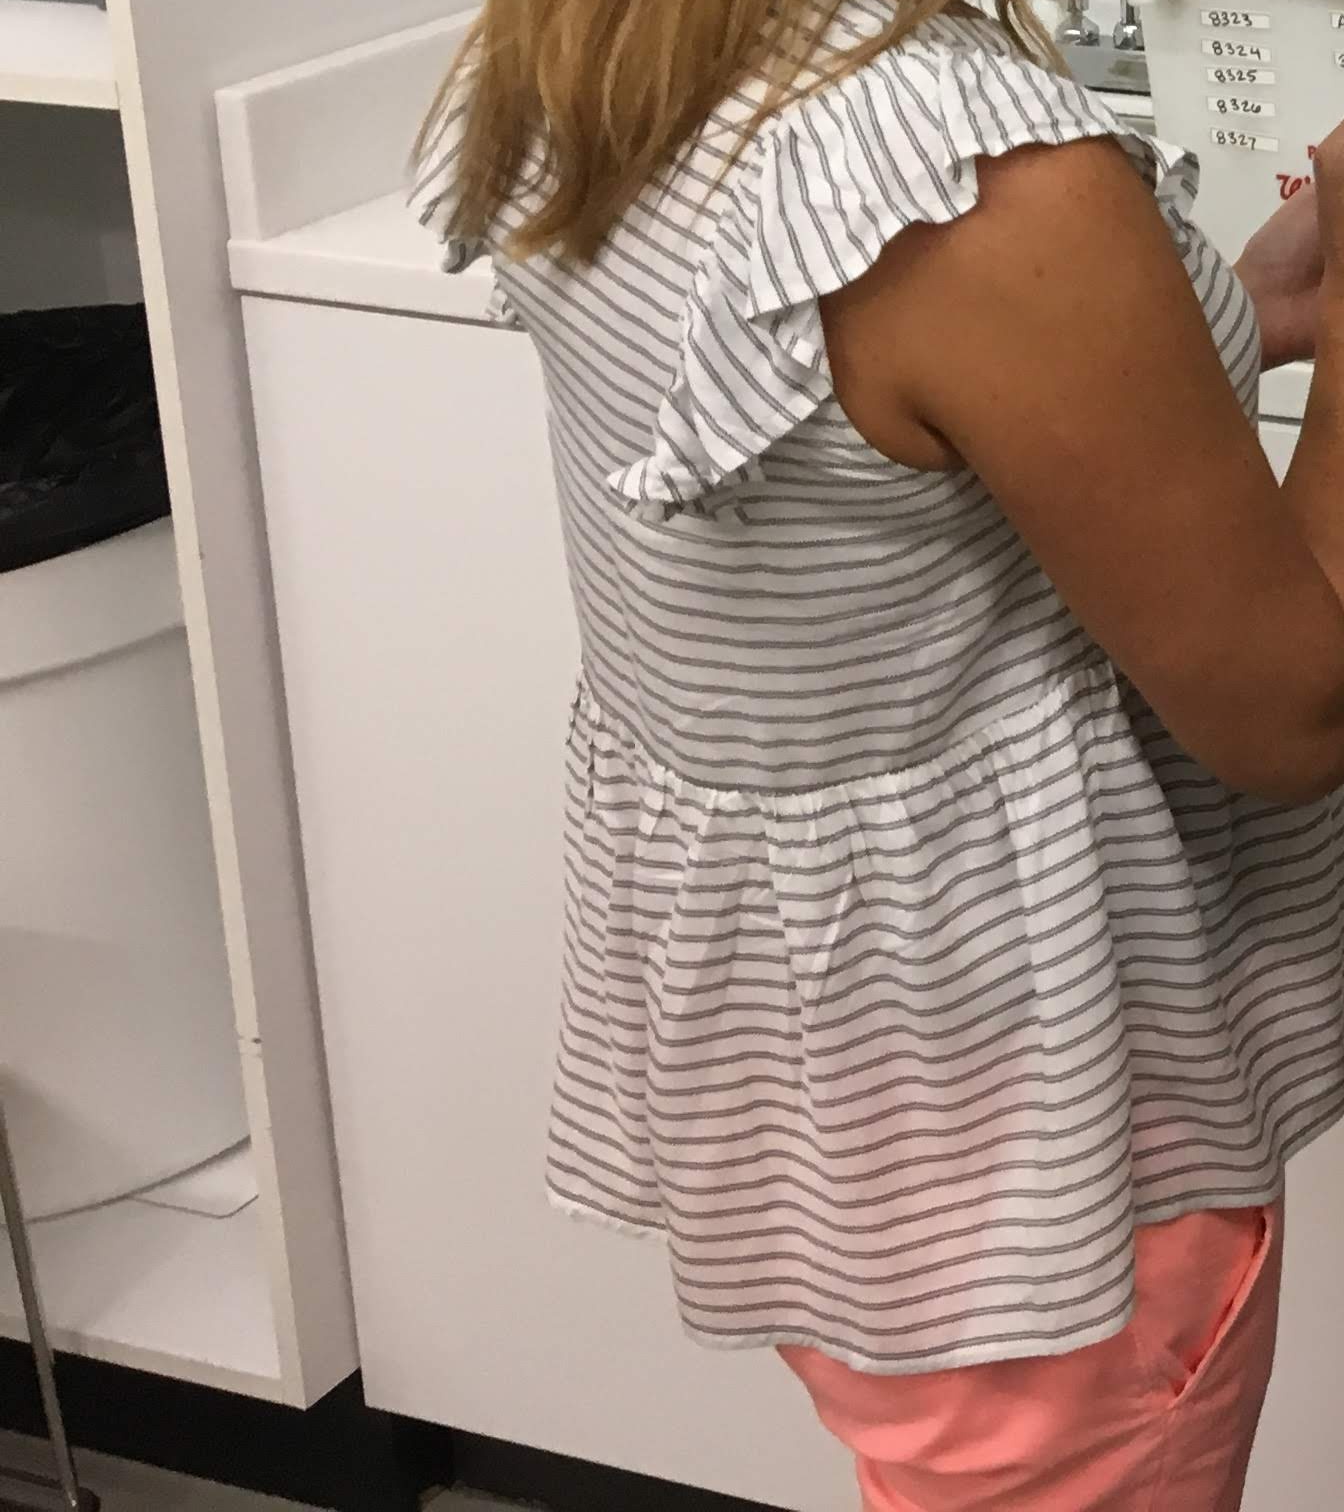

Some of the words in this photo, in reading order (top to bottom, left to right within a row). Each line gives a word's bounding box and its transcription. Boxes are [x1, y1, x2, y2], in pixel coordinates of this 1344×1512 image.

[1208, 10, 1253, 28] 8323
[1211, 40, 1262, 61] 8324
[1213, 69, 1258, 84] 8325
[1216, 97, 1262, 114] 8326
[1215, 130, 1257, 151] 8327
